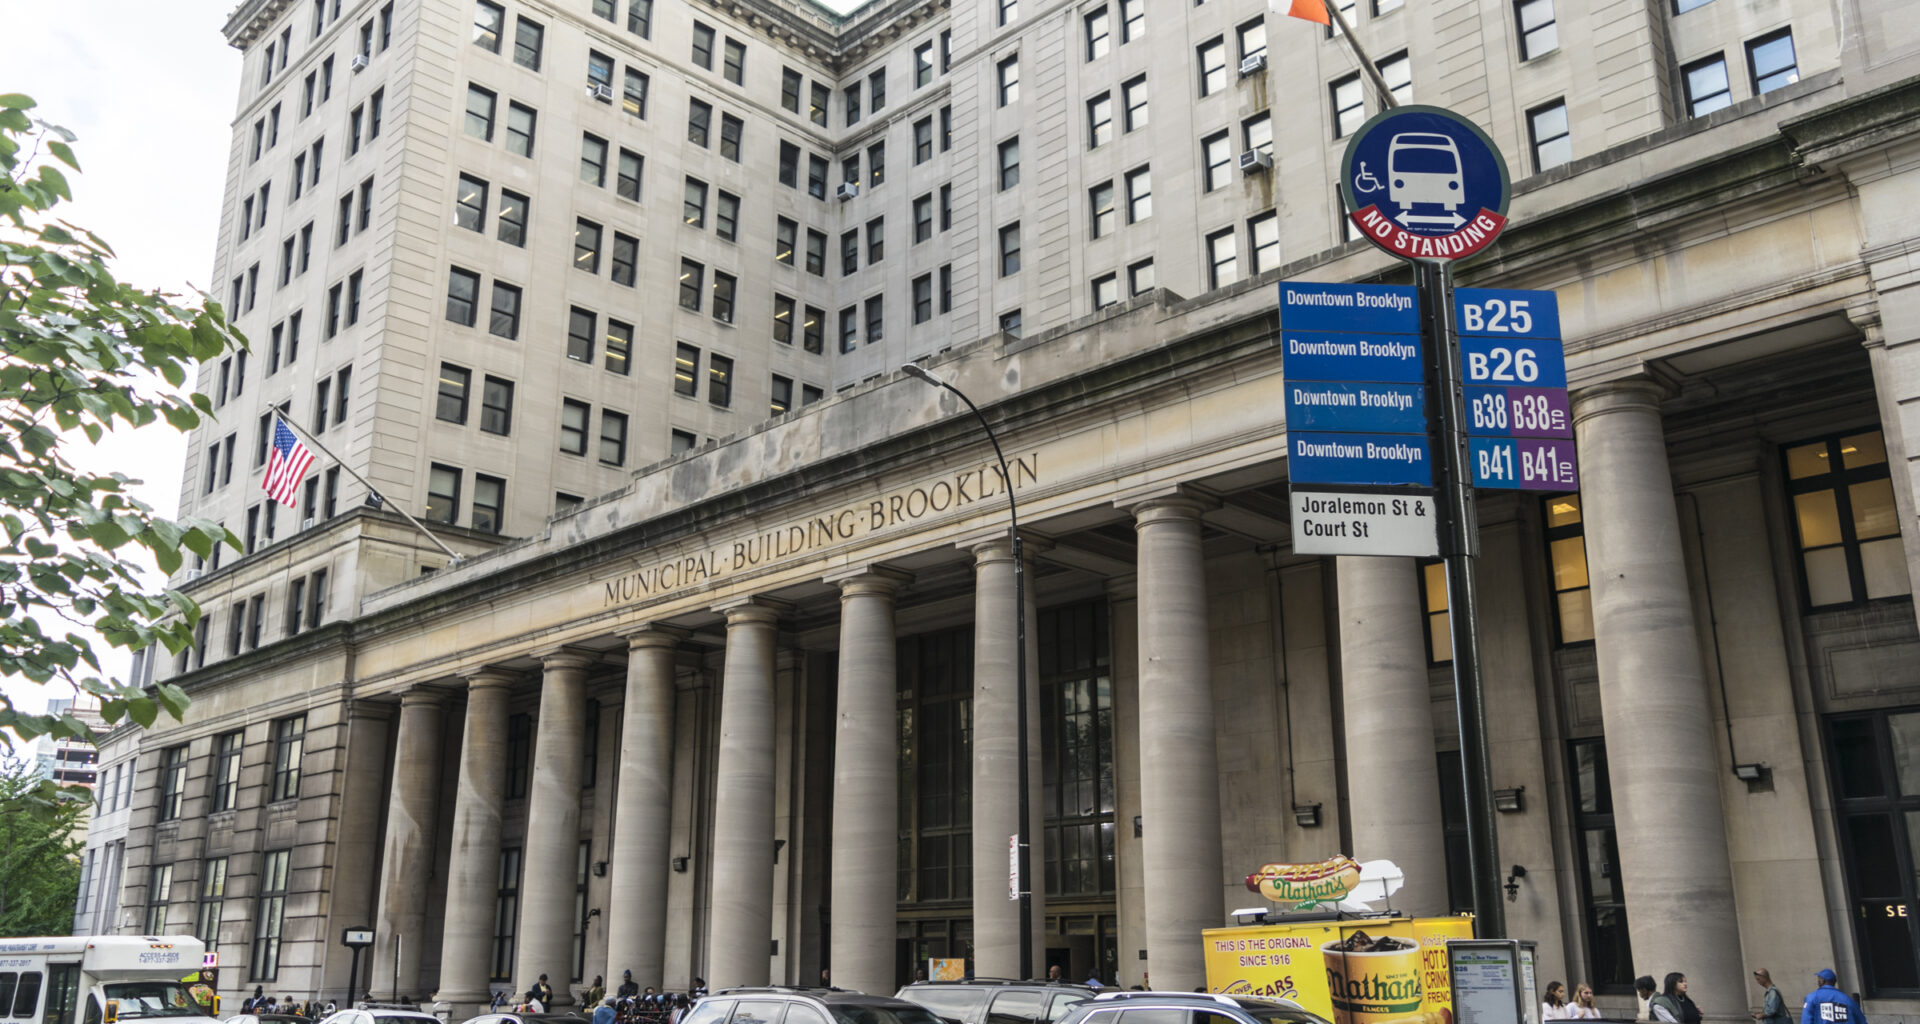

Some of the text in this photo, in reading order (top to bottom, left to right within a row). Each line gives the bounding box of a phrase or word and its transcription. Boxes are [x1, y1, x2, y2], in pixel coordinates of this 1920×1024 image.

[1362, 210, 1497, 256] NO STANDING
[1287, 290, 1412, 312] Downtown Brooklyn
[1464, 299, 1532, 333] B25
[1290, 339, 1416, 360] Downtown Brooklyn
[1469, 347, 1538, 382] B26
[1294, 389, 1413, 411] Downtown Brooklyn
[1473, 394, 1565, 430] B38 B38 LTD
[1297, 440, 1422, 464] Downtown Brooklyn
[1479, 445, 1574, 483] B41 B41 LTD
[1302, 497, 1426, 517] Joralemon St &
[604, 452, 1039, 607] MUNICIPAL BUILDING BROOKLYN
[1304, 519, 1369, 538] Court St
[1272, 876, 1345, 900] Nathan's
[1215, 937, 1312, 952] THIS IS THE ORIGNAL
[1240, 954, 1290, 967] SINCE 1916
[1422, 950, 1439, 970] HOT
[1326, 967, 1422, 1000] Nathan's
